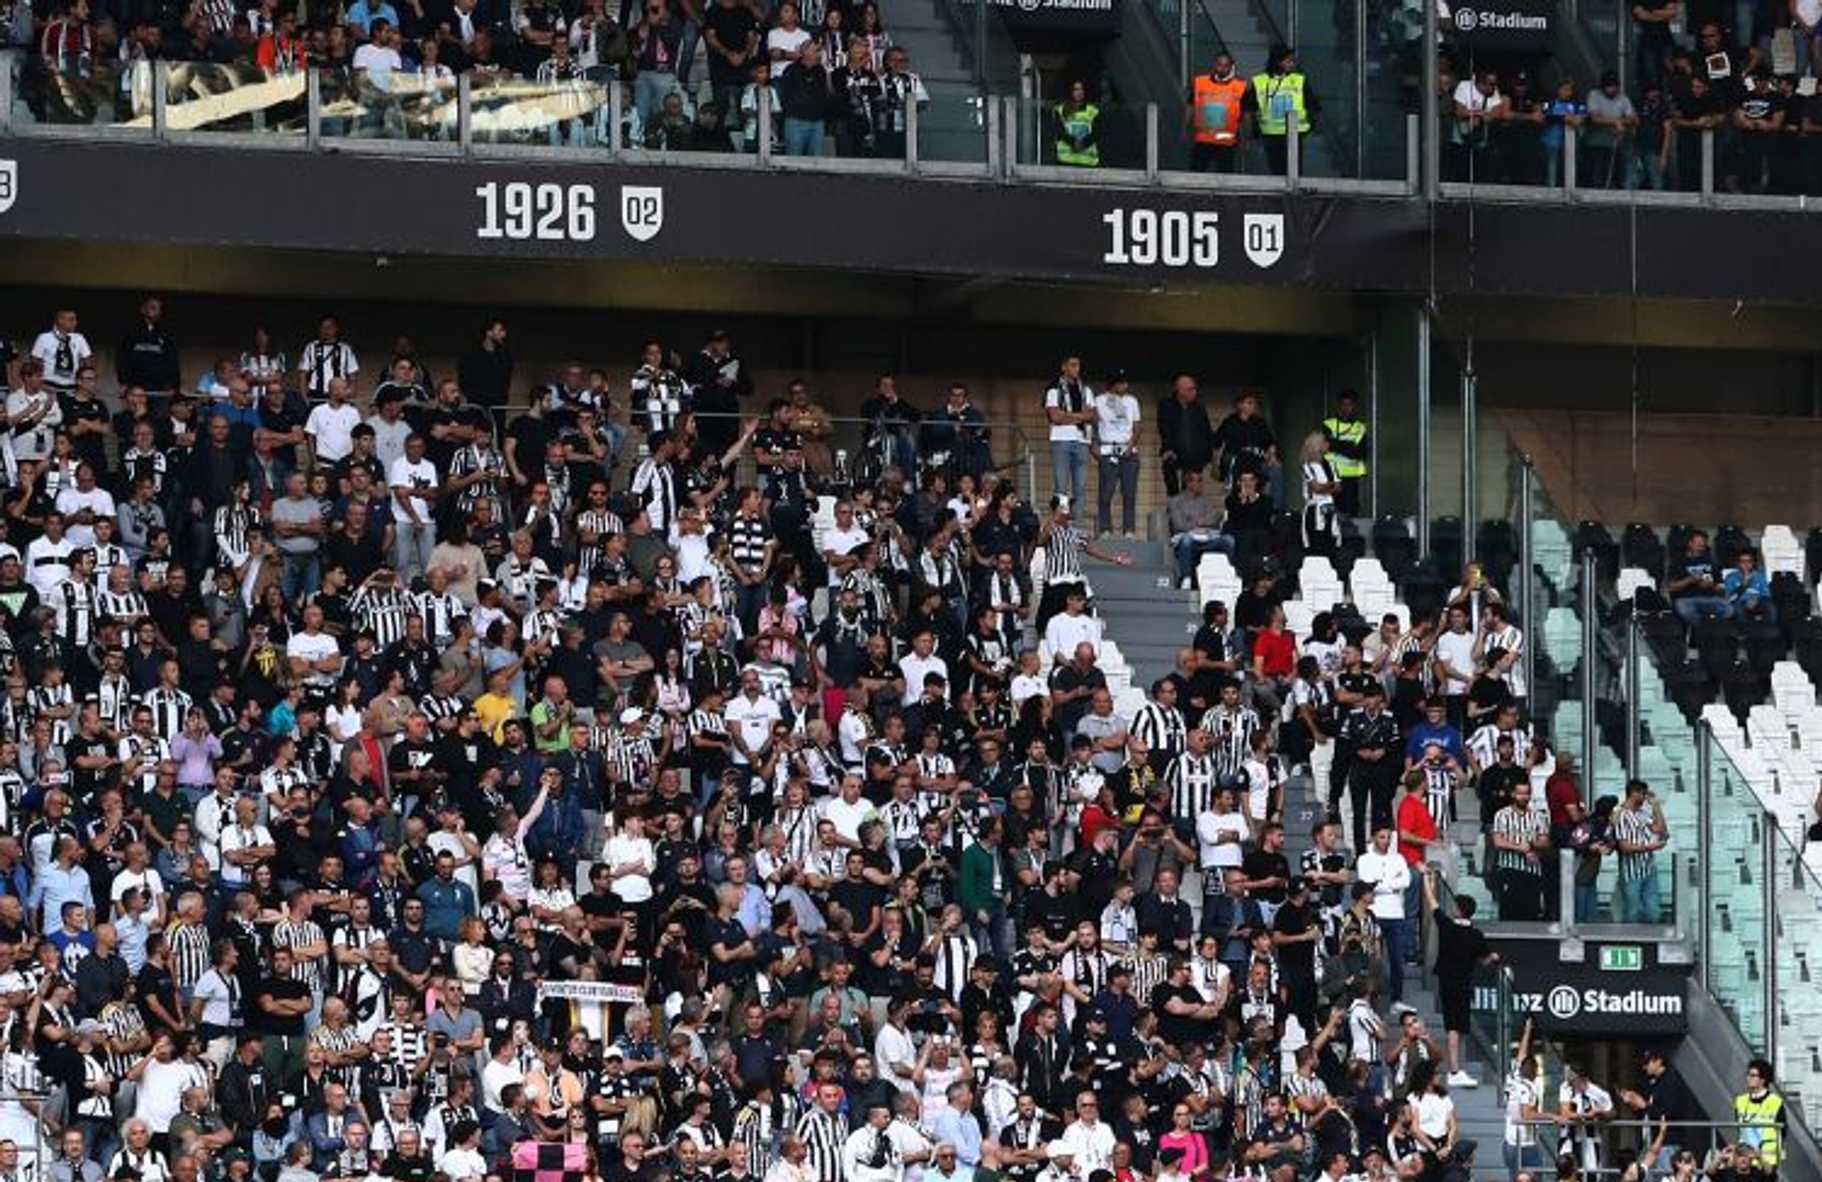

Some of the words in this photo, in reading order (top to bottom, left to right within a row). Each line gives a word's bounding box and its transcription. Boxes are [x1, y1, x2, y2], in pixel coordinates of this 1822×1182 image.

[1479, 11, 1547, 30] Stadium
[475, 181, 596, 241] 1926
[626, 195, 658, 226] 02
[1103, 208, 1219, 268] 1905
[1249, 223, 1279, 252] 01
[1582, 989, 1683, 1015] Stadium
